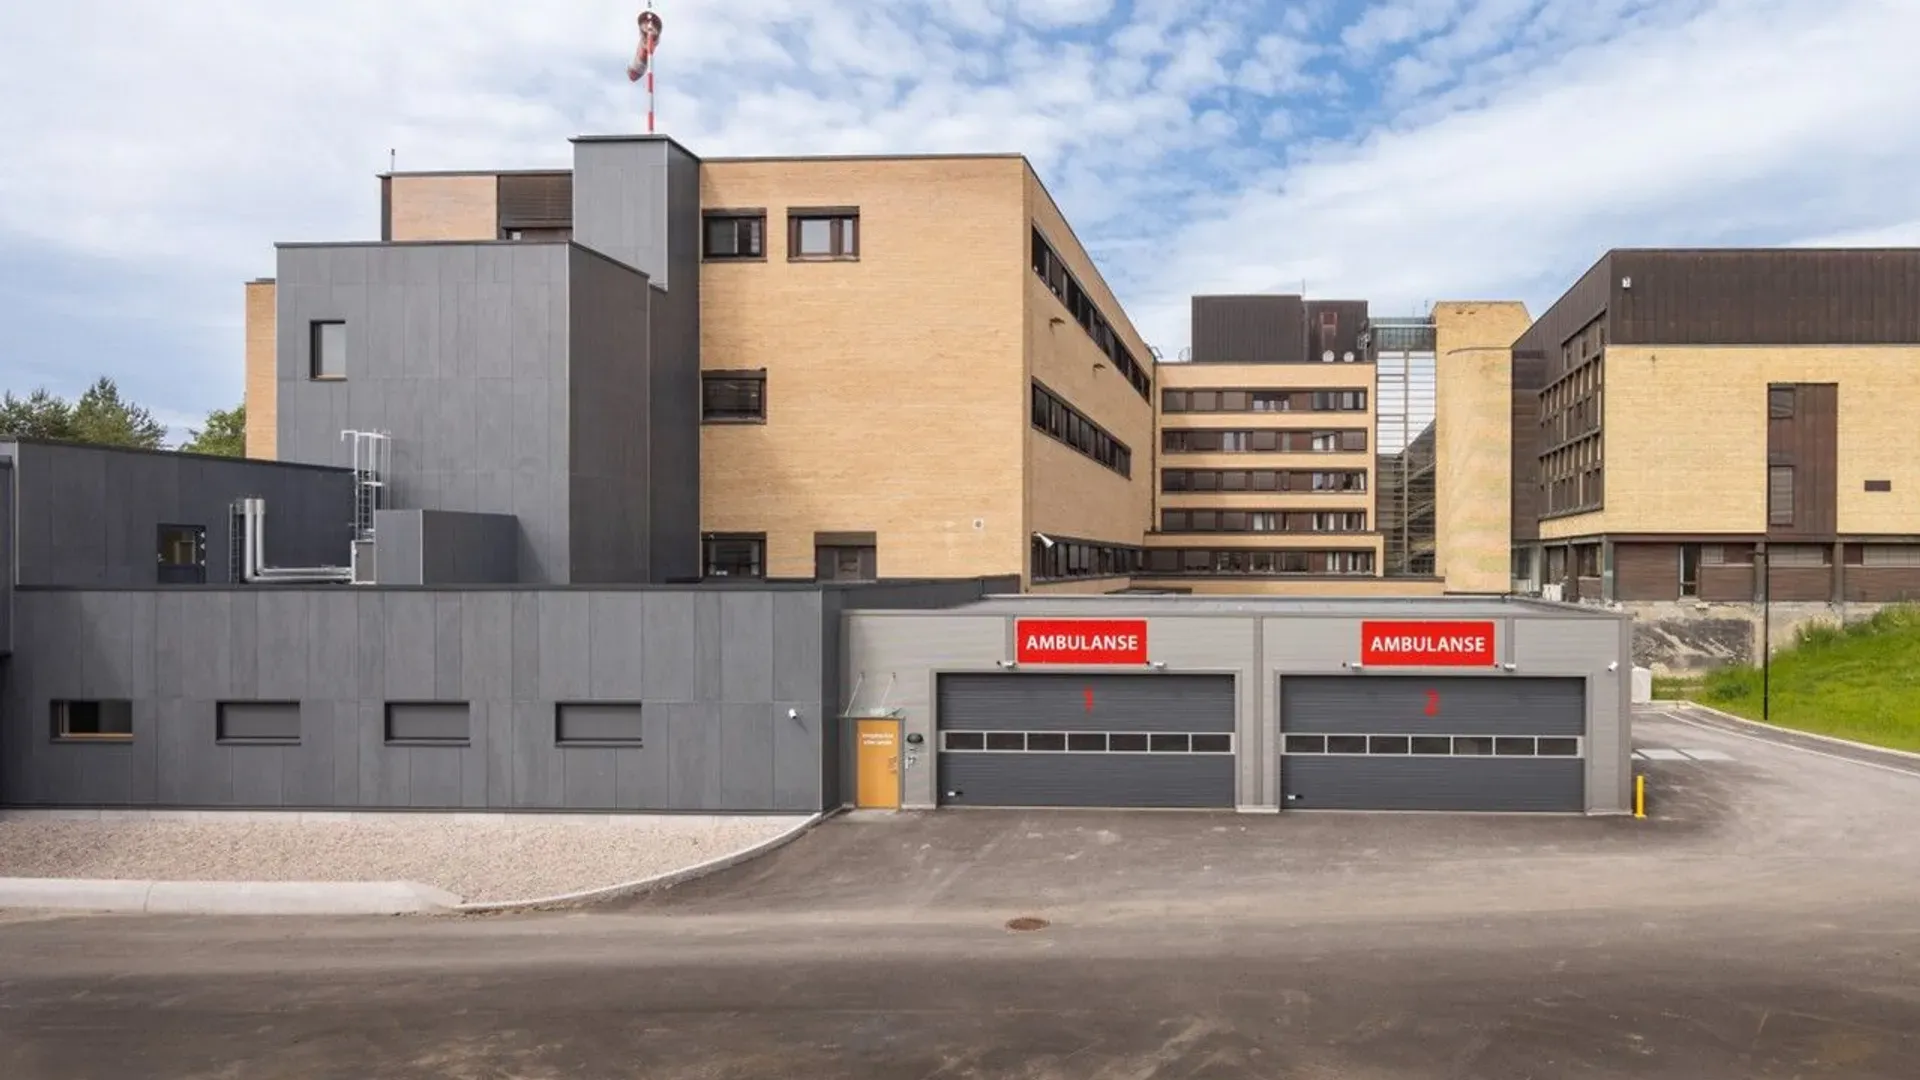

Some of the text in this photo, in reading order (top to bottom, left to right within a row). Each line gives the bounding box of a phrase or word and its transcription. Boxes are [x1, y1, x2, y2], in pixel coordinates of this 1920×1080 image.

[1026, 634, 1138, 651] AMBULANSE
[1370, 636, 1486, 652] AMBULANSE
[1083, 687, 1094, 713] 1
[1423, 688, 1440, 716] 2
